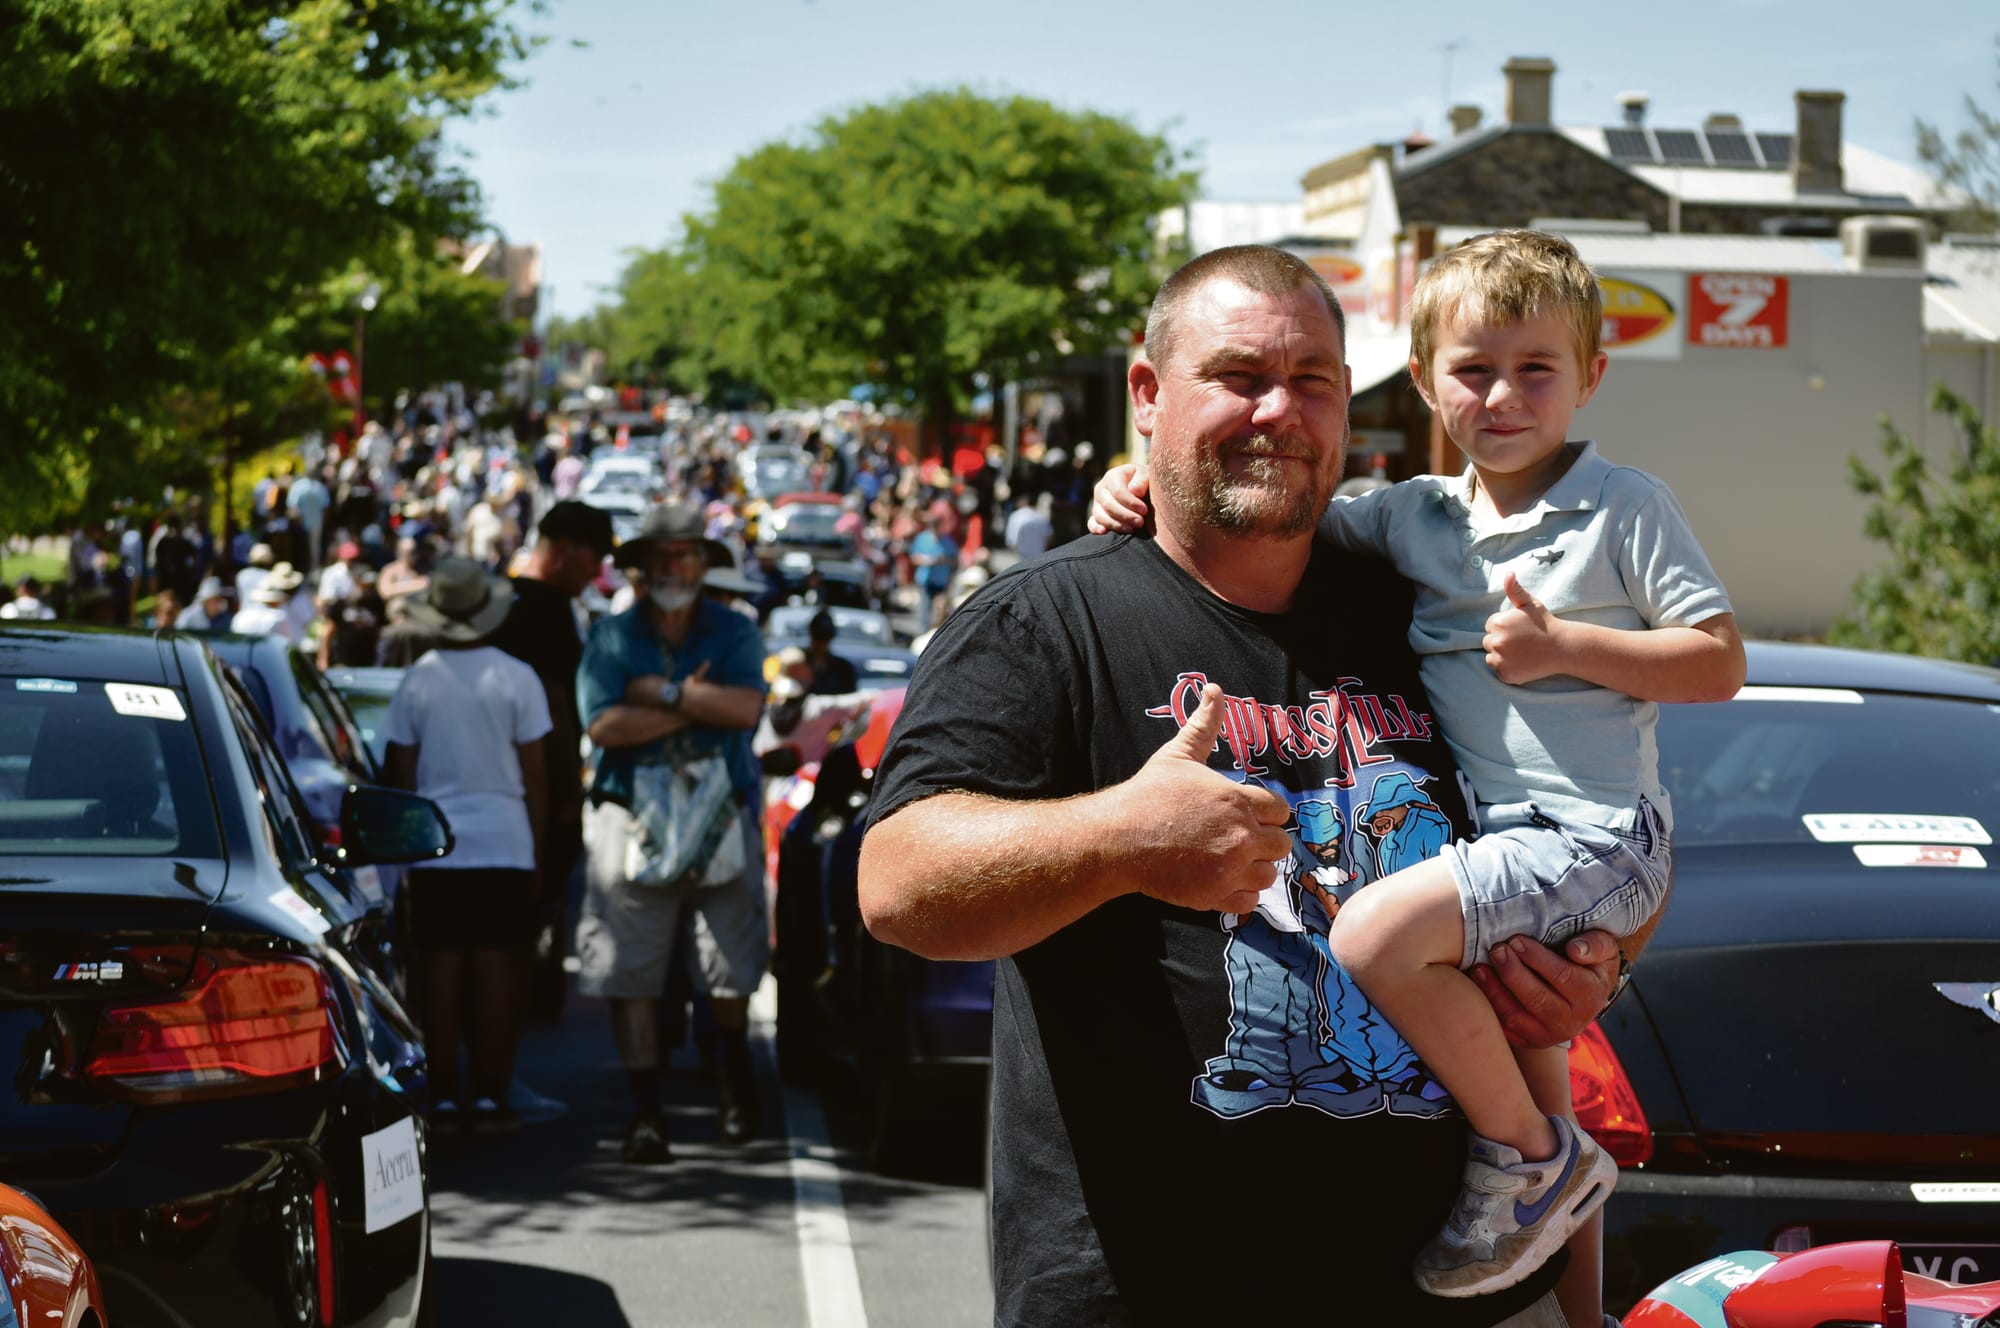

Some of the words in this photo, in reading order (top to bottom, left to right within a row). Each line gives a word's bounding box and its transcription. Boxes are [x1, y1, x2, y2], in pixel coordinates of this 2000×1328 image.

[1700, 274, 1776, 297] OPEN
[1710, 294, 1769, 326] 7
[1702, 322, 1773, 347] DAYS
